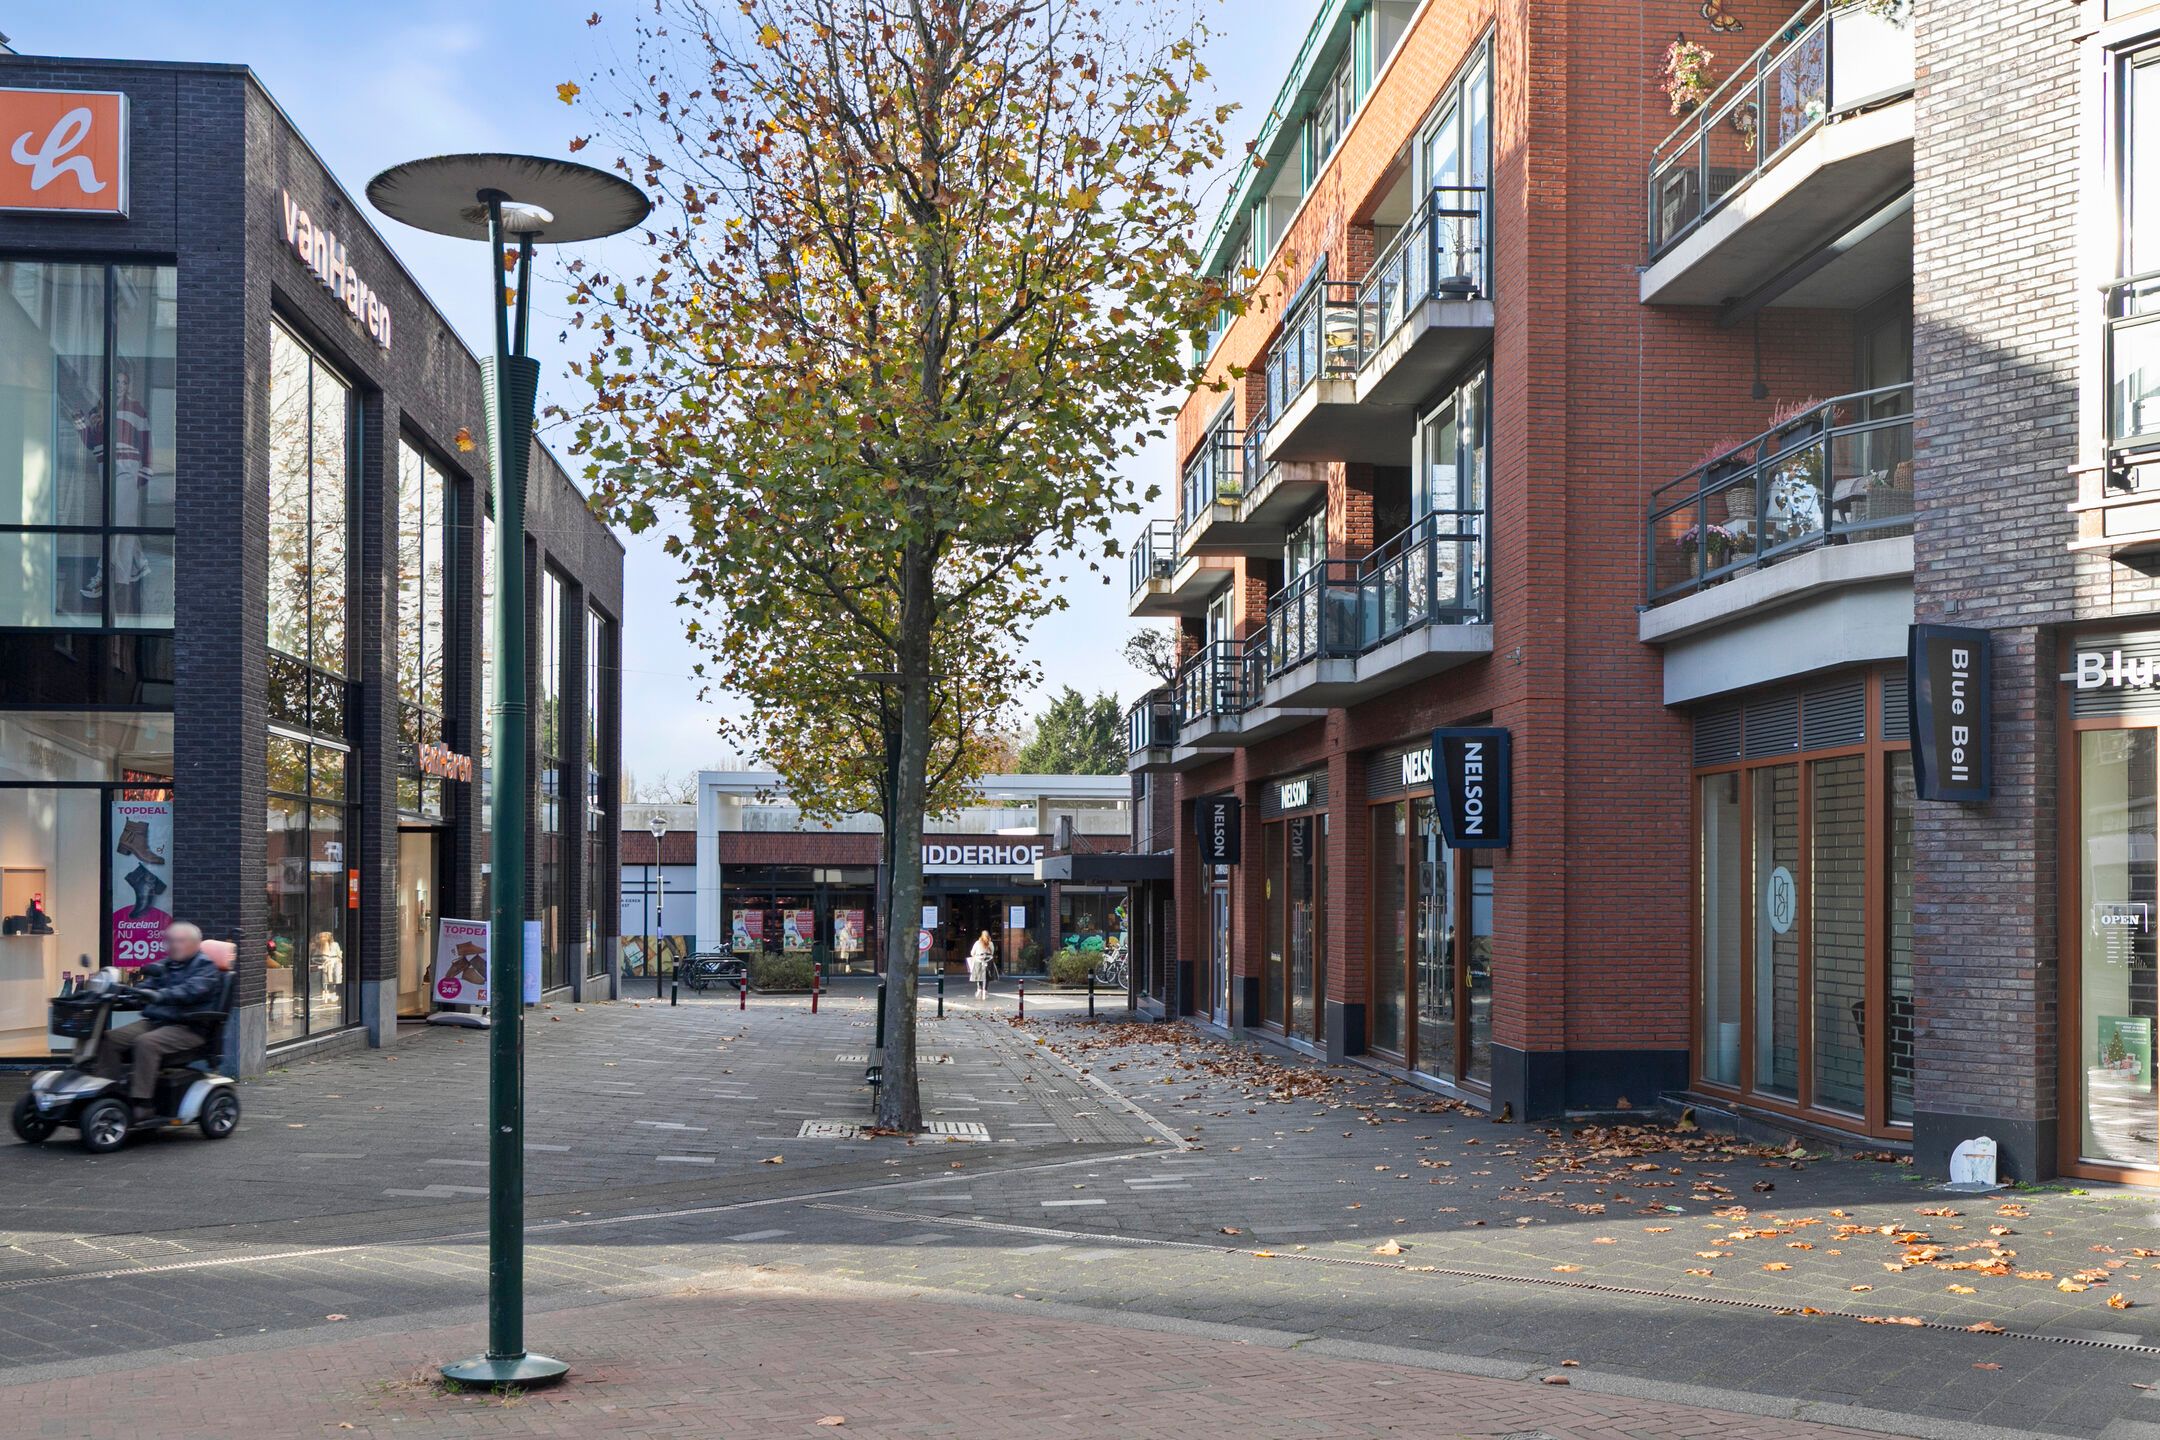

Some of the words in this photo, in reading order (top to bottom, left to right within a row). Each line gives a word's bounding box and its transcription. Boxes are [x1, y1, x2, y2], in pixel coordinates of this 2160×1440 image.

[281, 188, 391, 350] vanHaren
[1951, 648, 1969, 715] Blue
[2077, 650, 2160, 689] Blu
[1951, 725, 1969, 781] Bell
[1281, 780, 1308, 809] NELSON
[1464, 742, 1483, 835] NELSON
[117, 806, 168, 815] TOPDEAL
[1214, 804, 1225, 857] NELSON
[117, 920, 160, 929] Graceland
[117, 930, 134, 939] NU
[2101, 914, 2140, 926] OPEN
